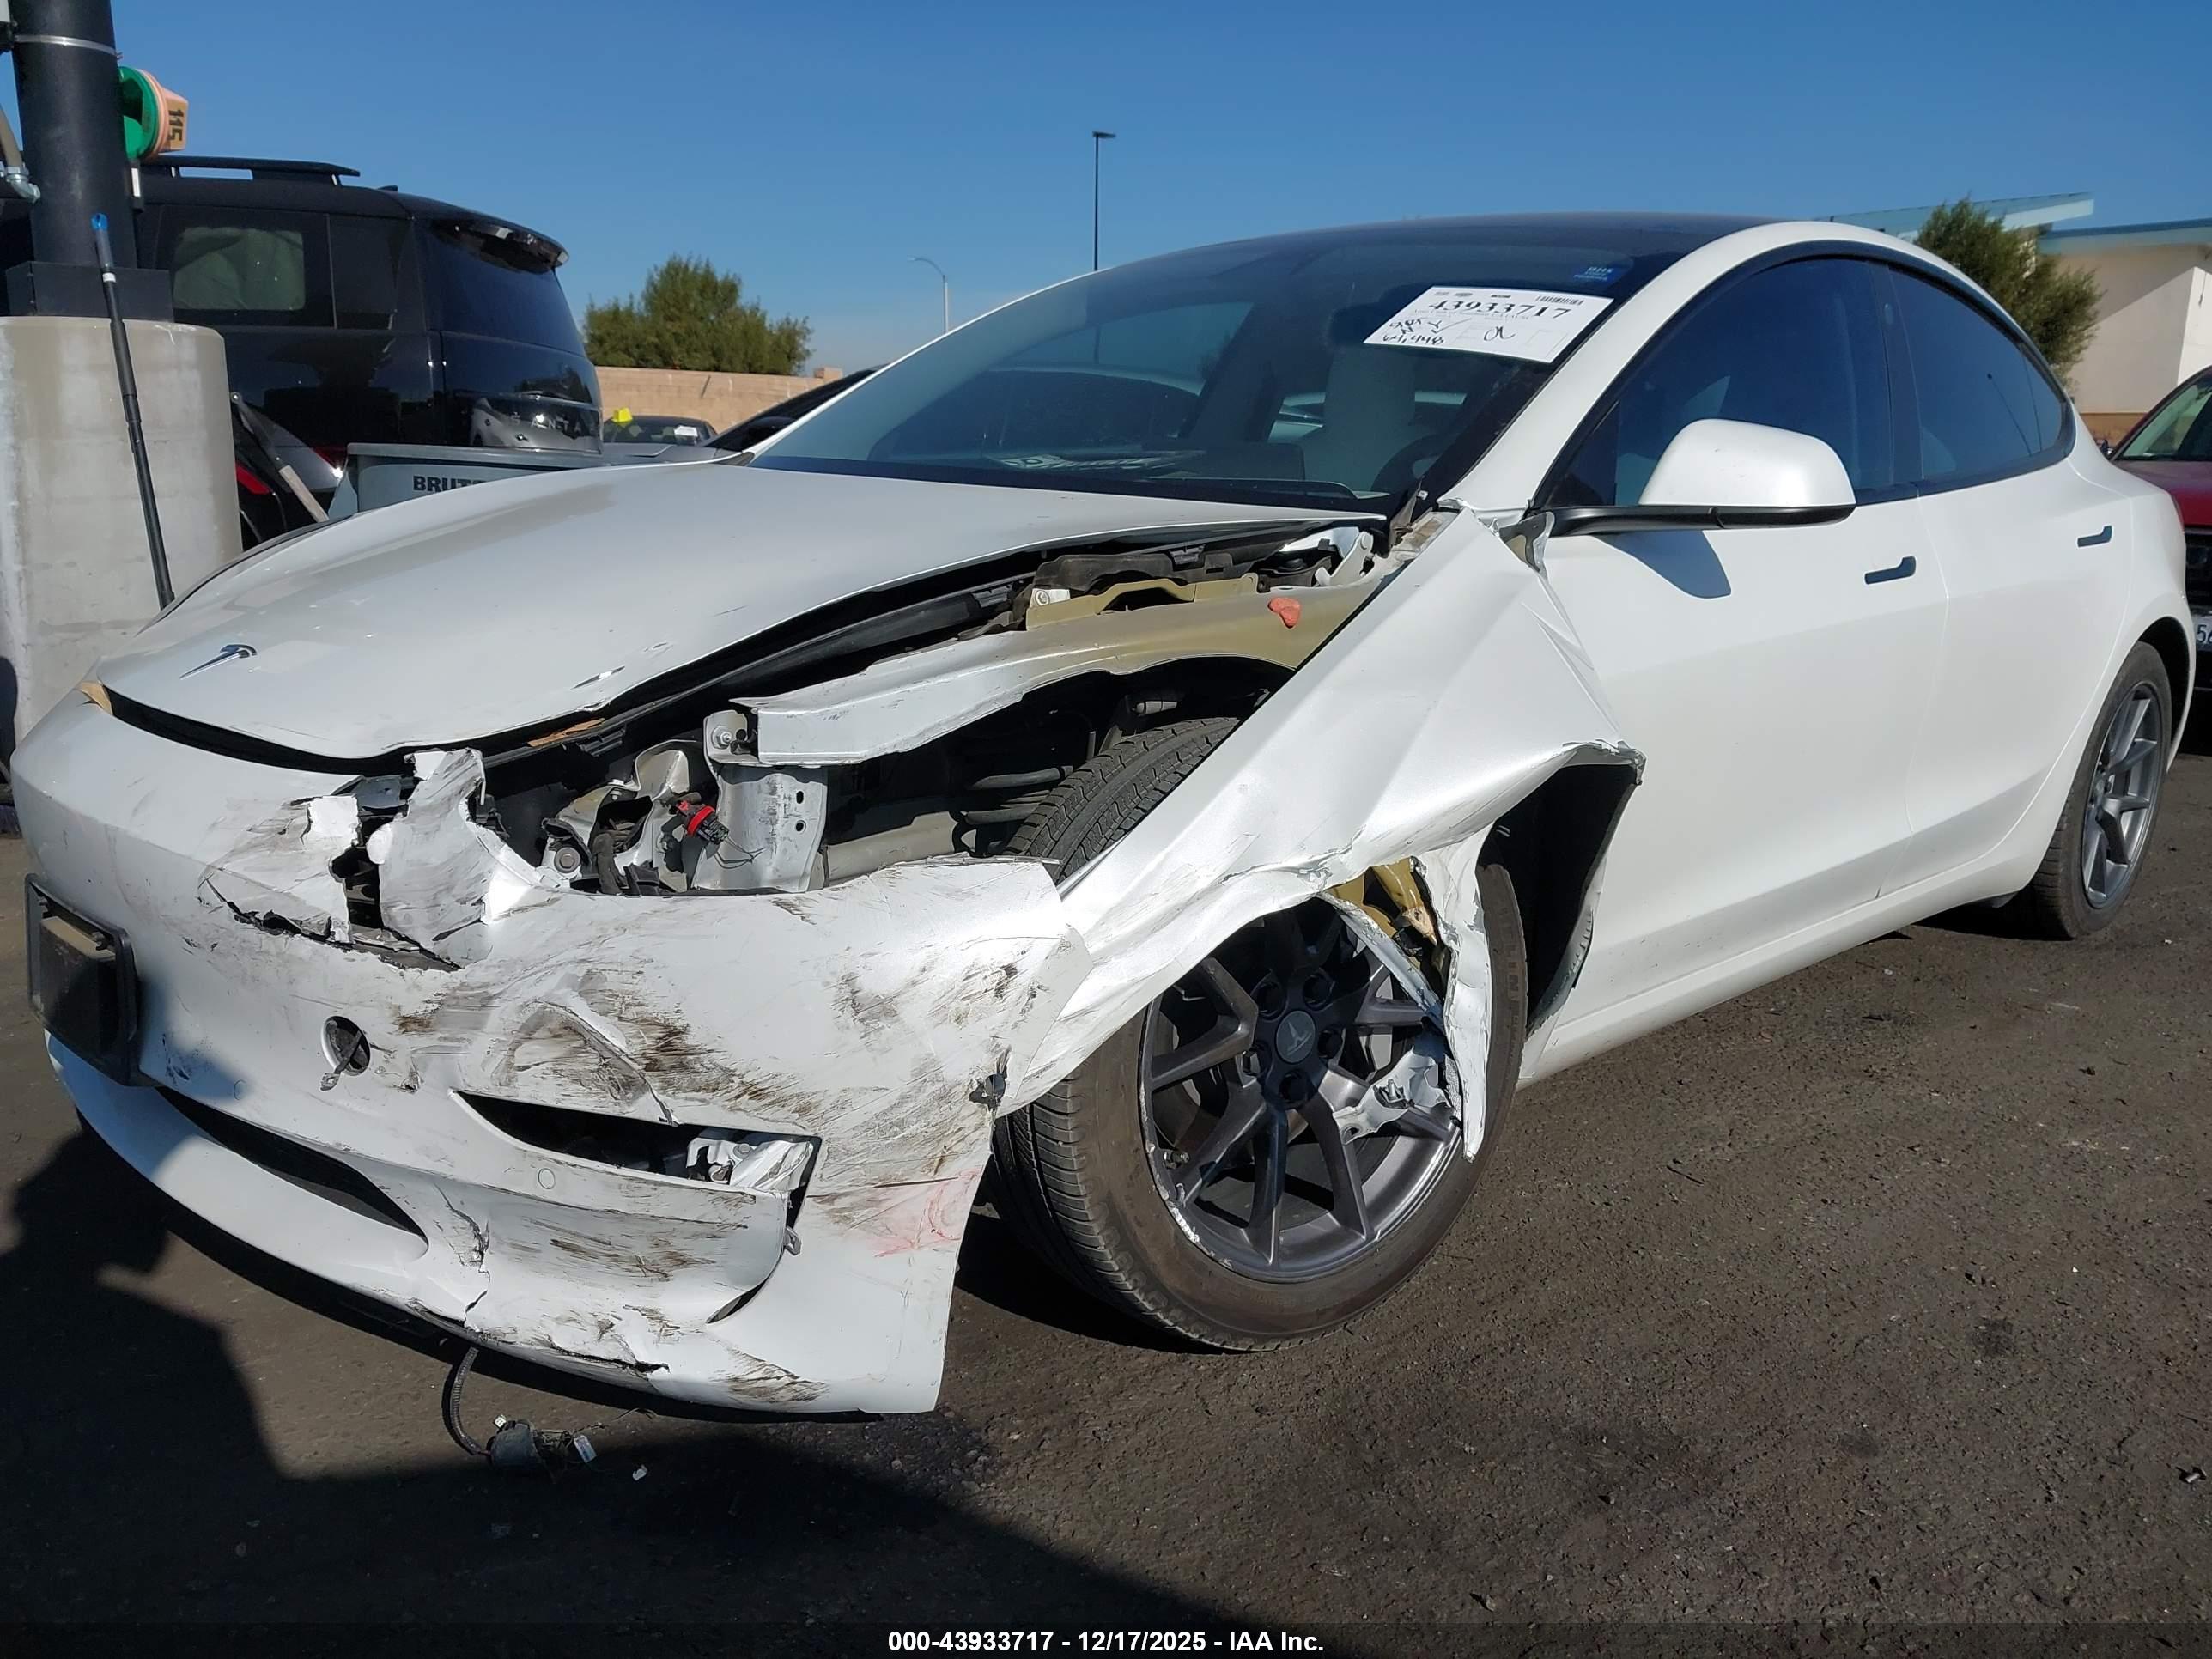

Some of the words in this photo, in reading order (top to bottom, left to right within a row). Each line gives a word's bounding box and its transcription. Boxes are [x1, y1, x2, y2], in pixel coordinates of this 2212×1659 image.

[167, 109, 185, 141] 115
[1428, 299, 1571, 319] 43933717
[413, 475, 487, 493] BRUT
